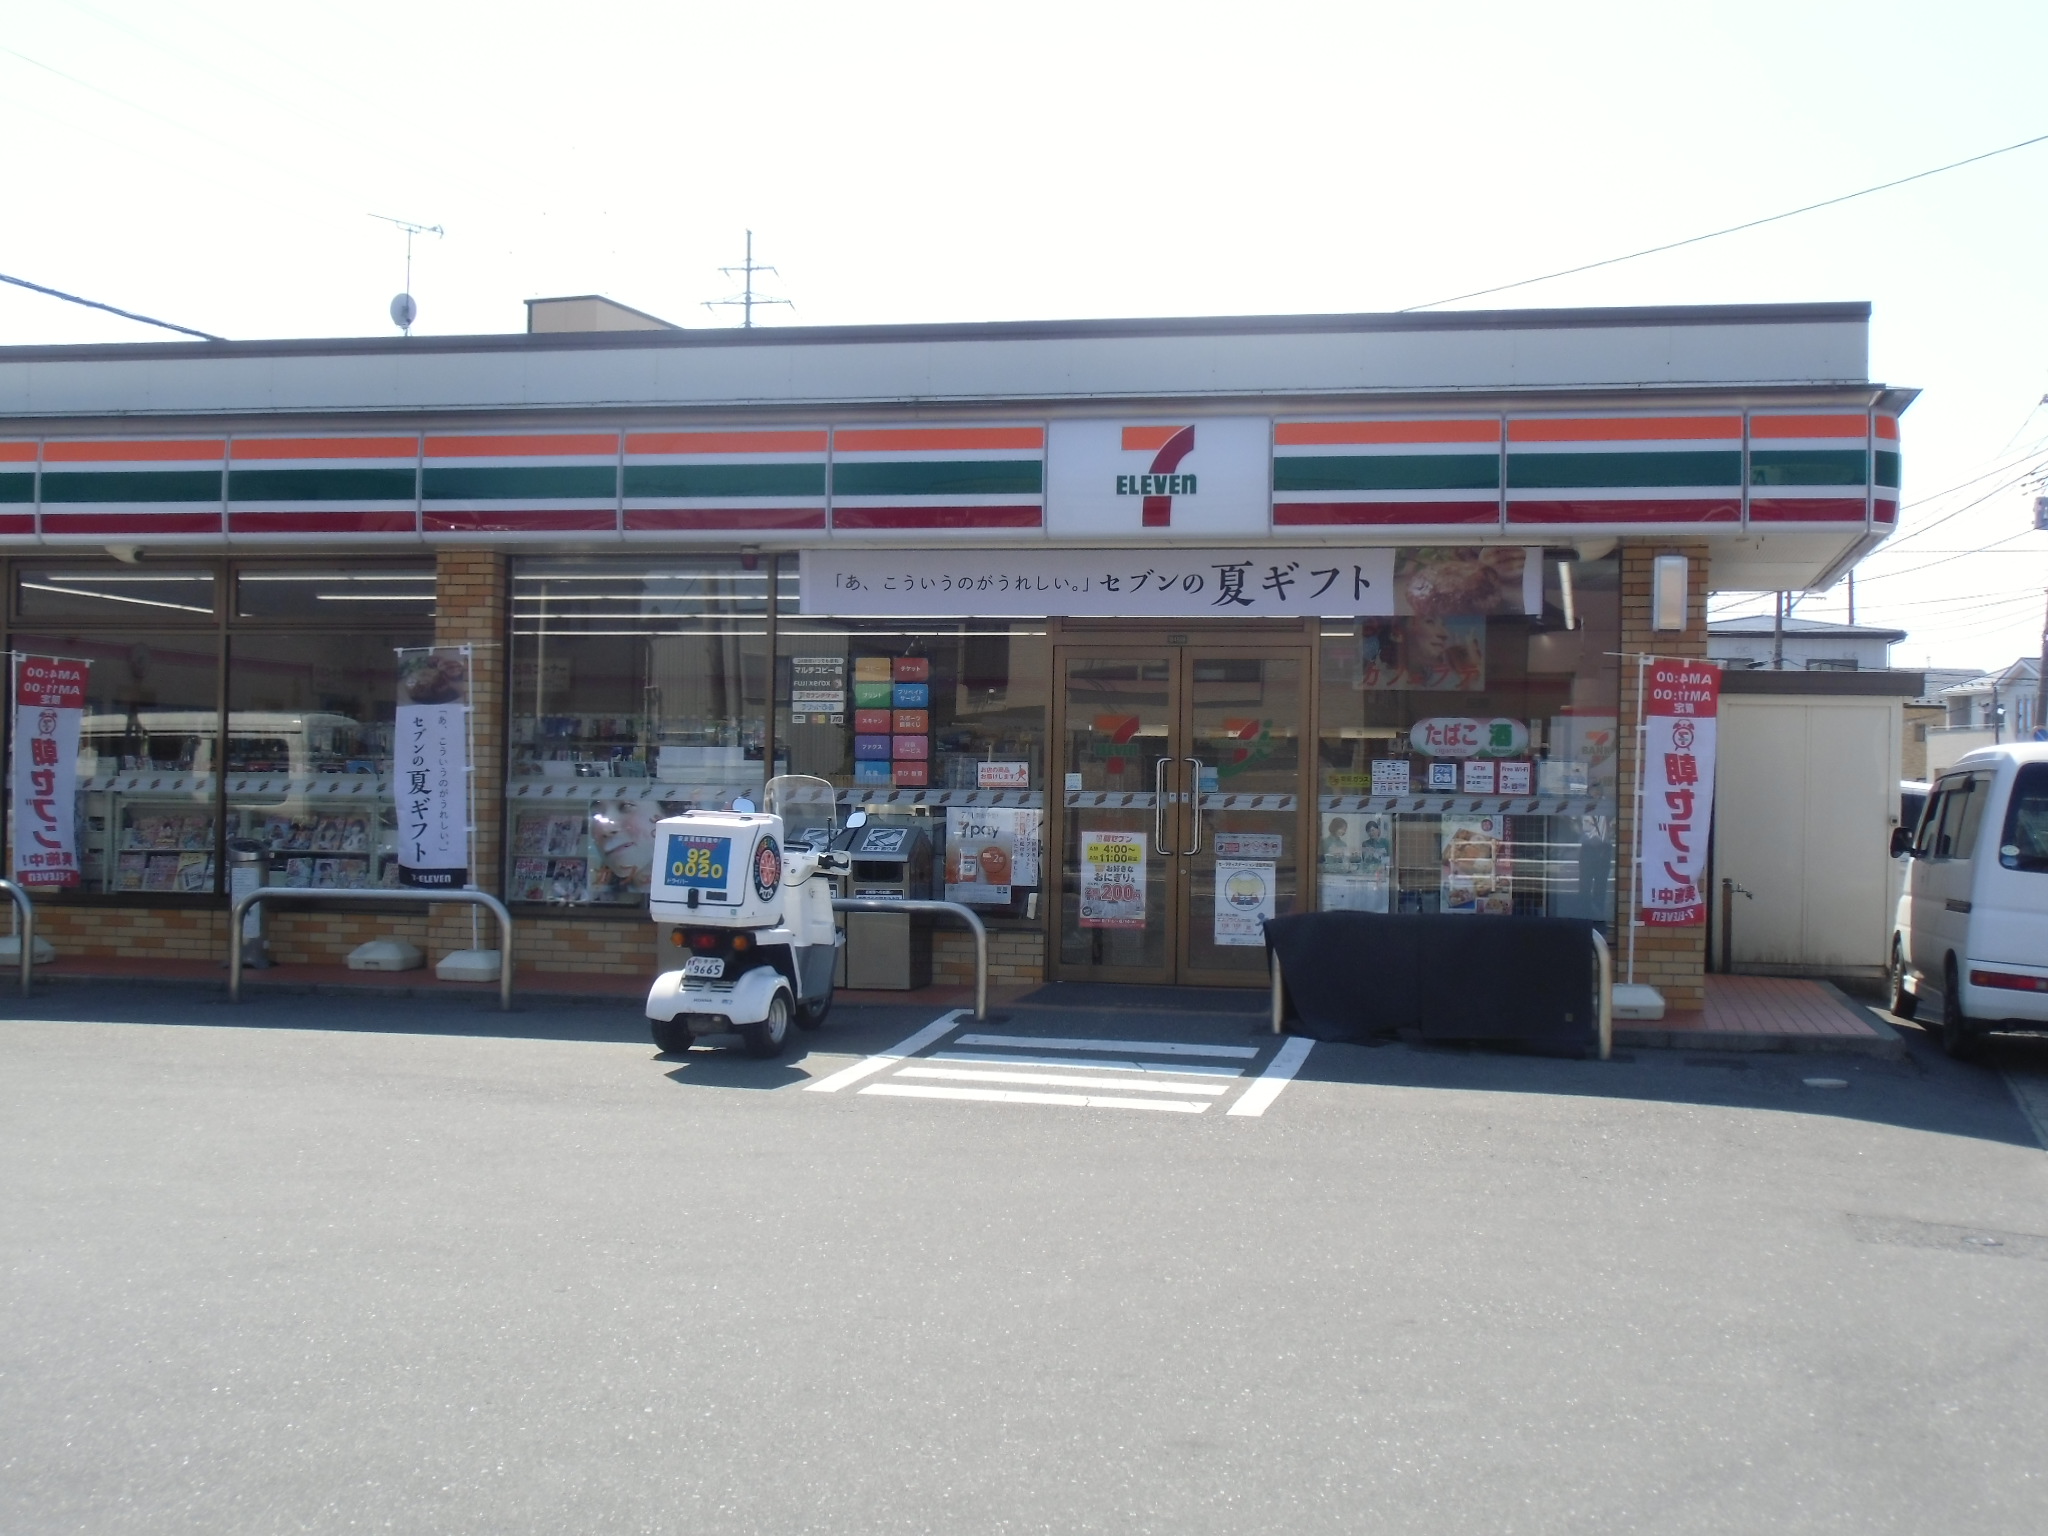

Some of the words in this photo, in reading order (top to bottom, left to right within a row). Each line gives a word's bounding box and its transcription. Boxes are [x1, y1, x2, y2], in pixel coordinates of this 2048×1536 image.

[1099, 559, 1373, 607] セブンの夏ギフト
[1425, 723, 1478, 746] たばこ
[406, 716, 432, 863] セブンの夏ギフト
[687, 848, 711, 864] 92
[672, 861, 723, 879] 0020
[693, 965, 722, 975] 9665
